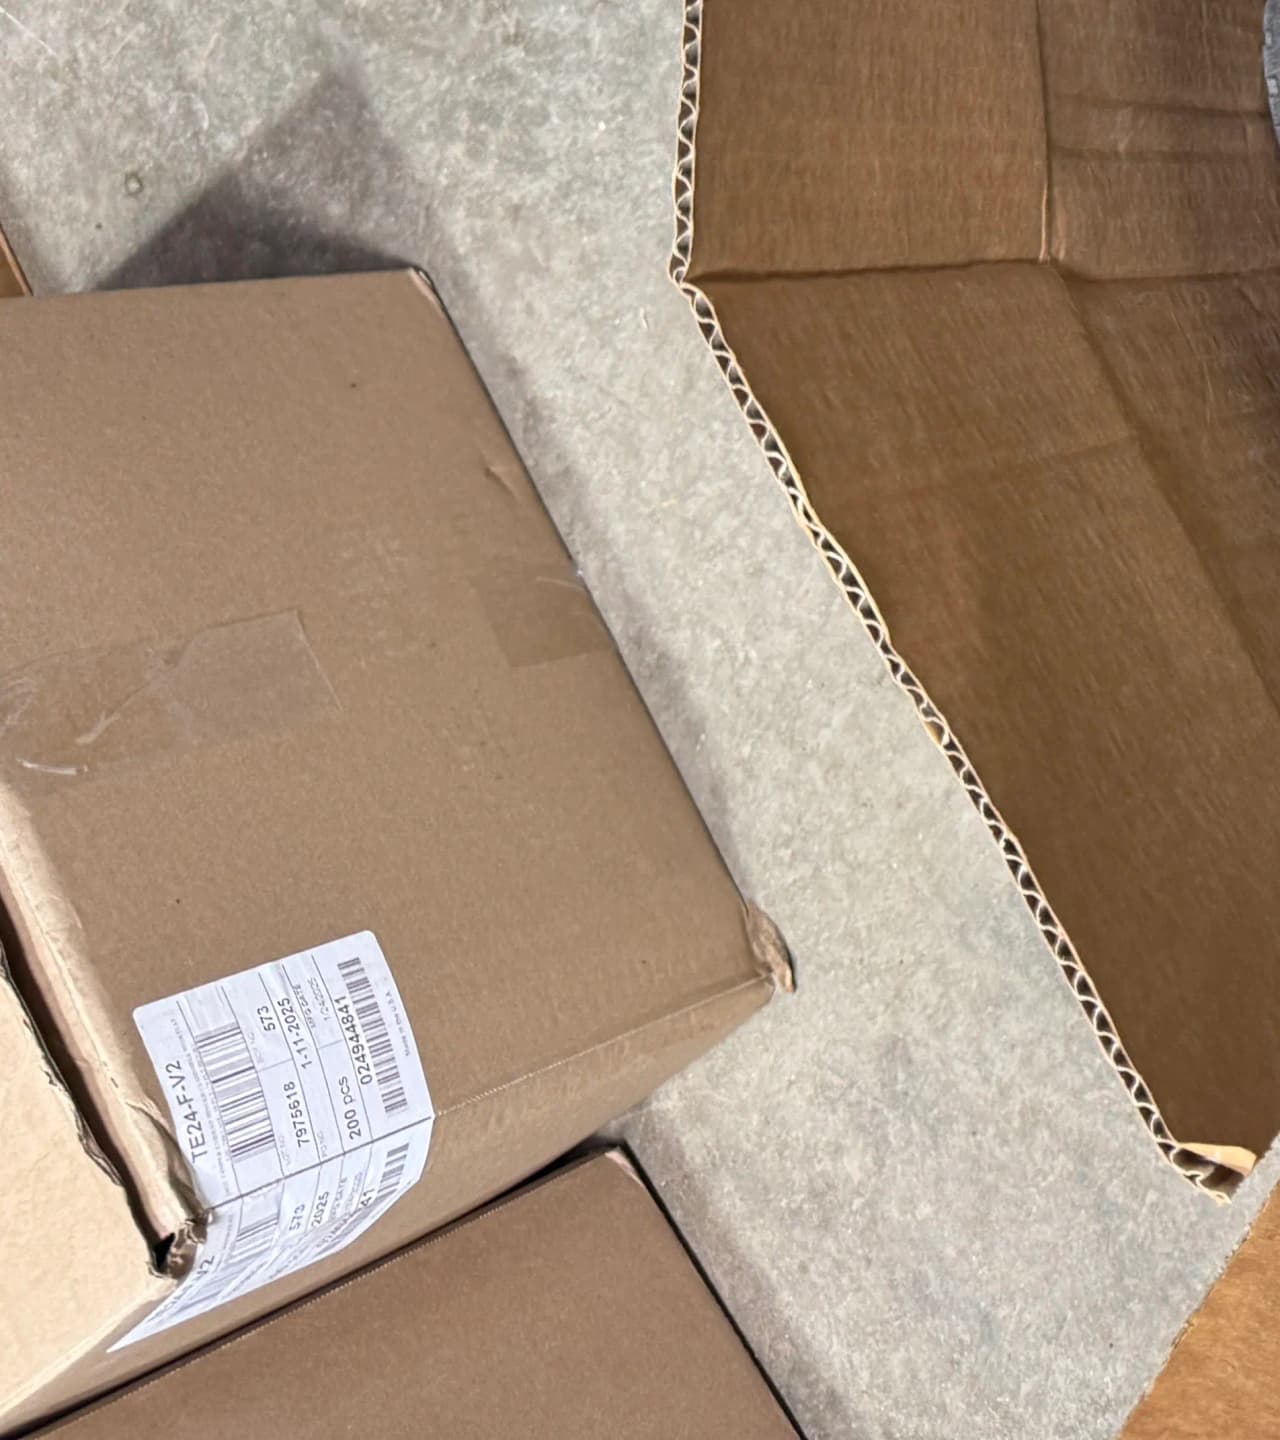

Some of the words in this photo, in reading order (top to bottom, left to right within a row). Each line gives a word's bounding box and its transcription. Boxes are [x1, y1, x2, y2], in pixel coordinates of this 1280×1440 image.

[256, 1003, 277, 1032] 573
[277, 996, 312, 1069] 1-11-2025
[334, 994, 373, 1085] 024944841
[164, 1059, 209, 1161] TE24-F-V2
[282, 1080, 310, 1147] 7975618
[335, 1074, 356, 1104] pcs
[343, 1108, 362, 1139] 200
